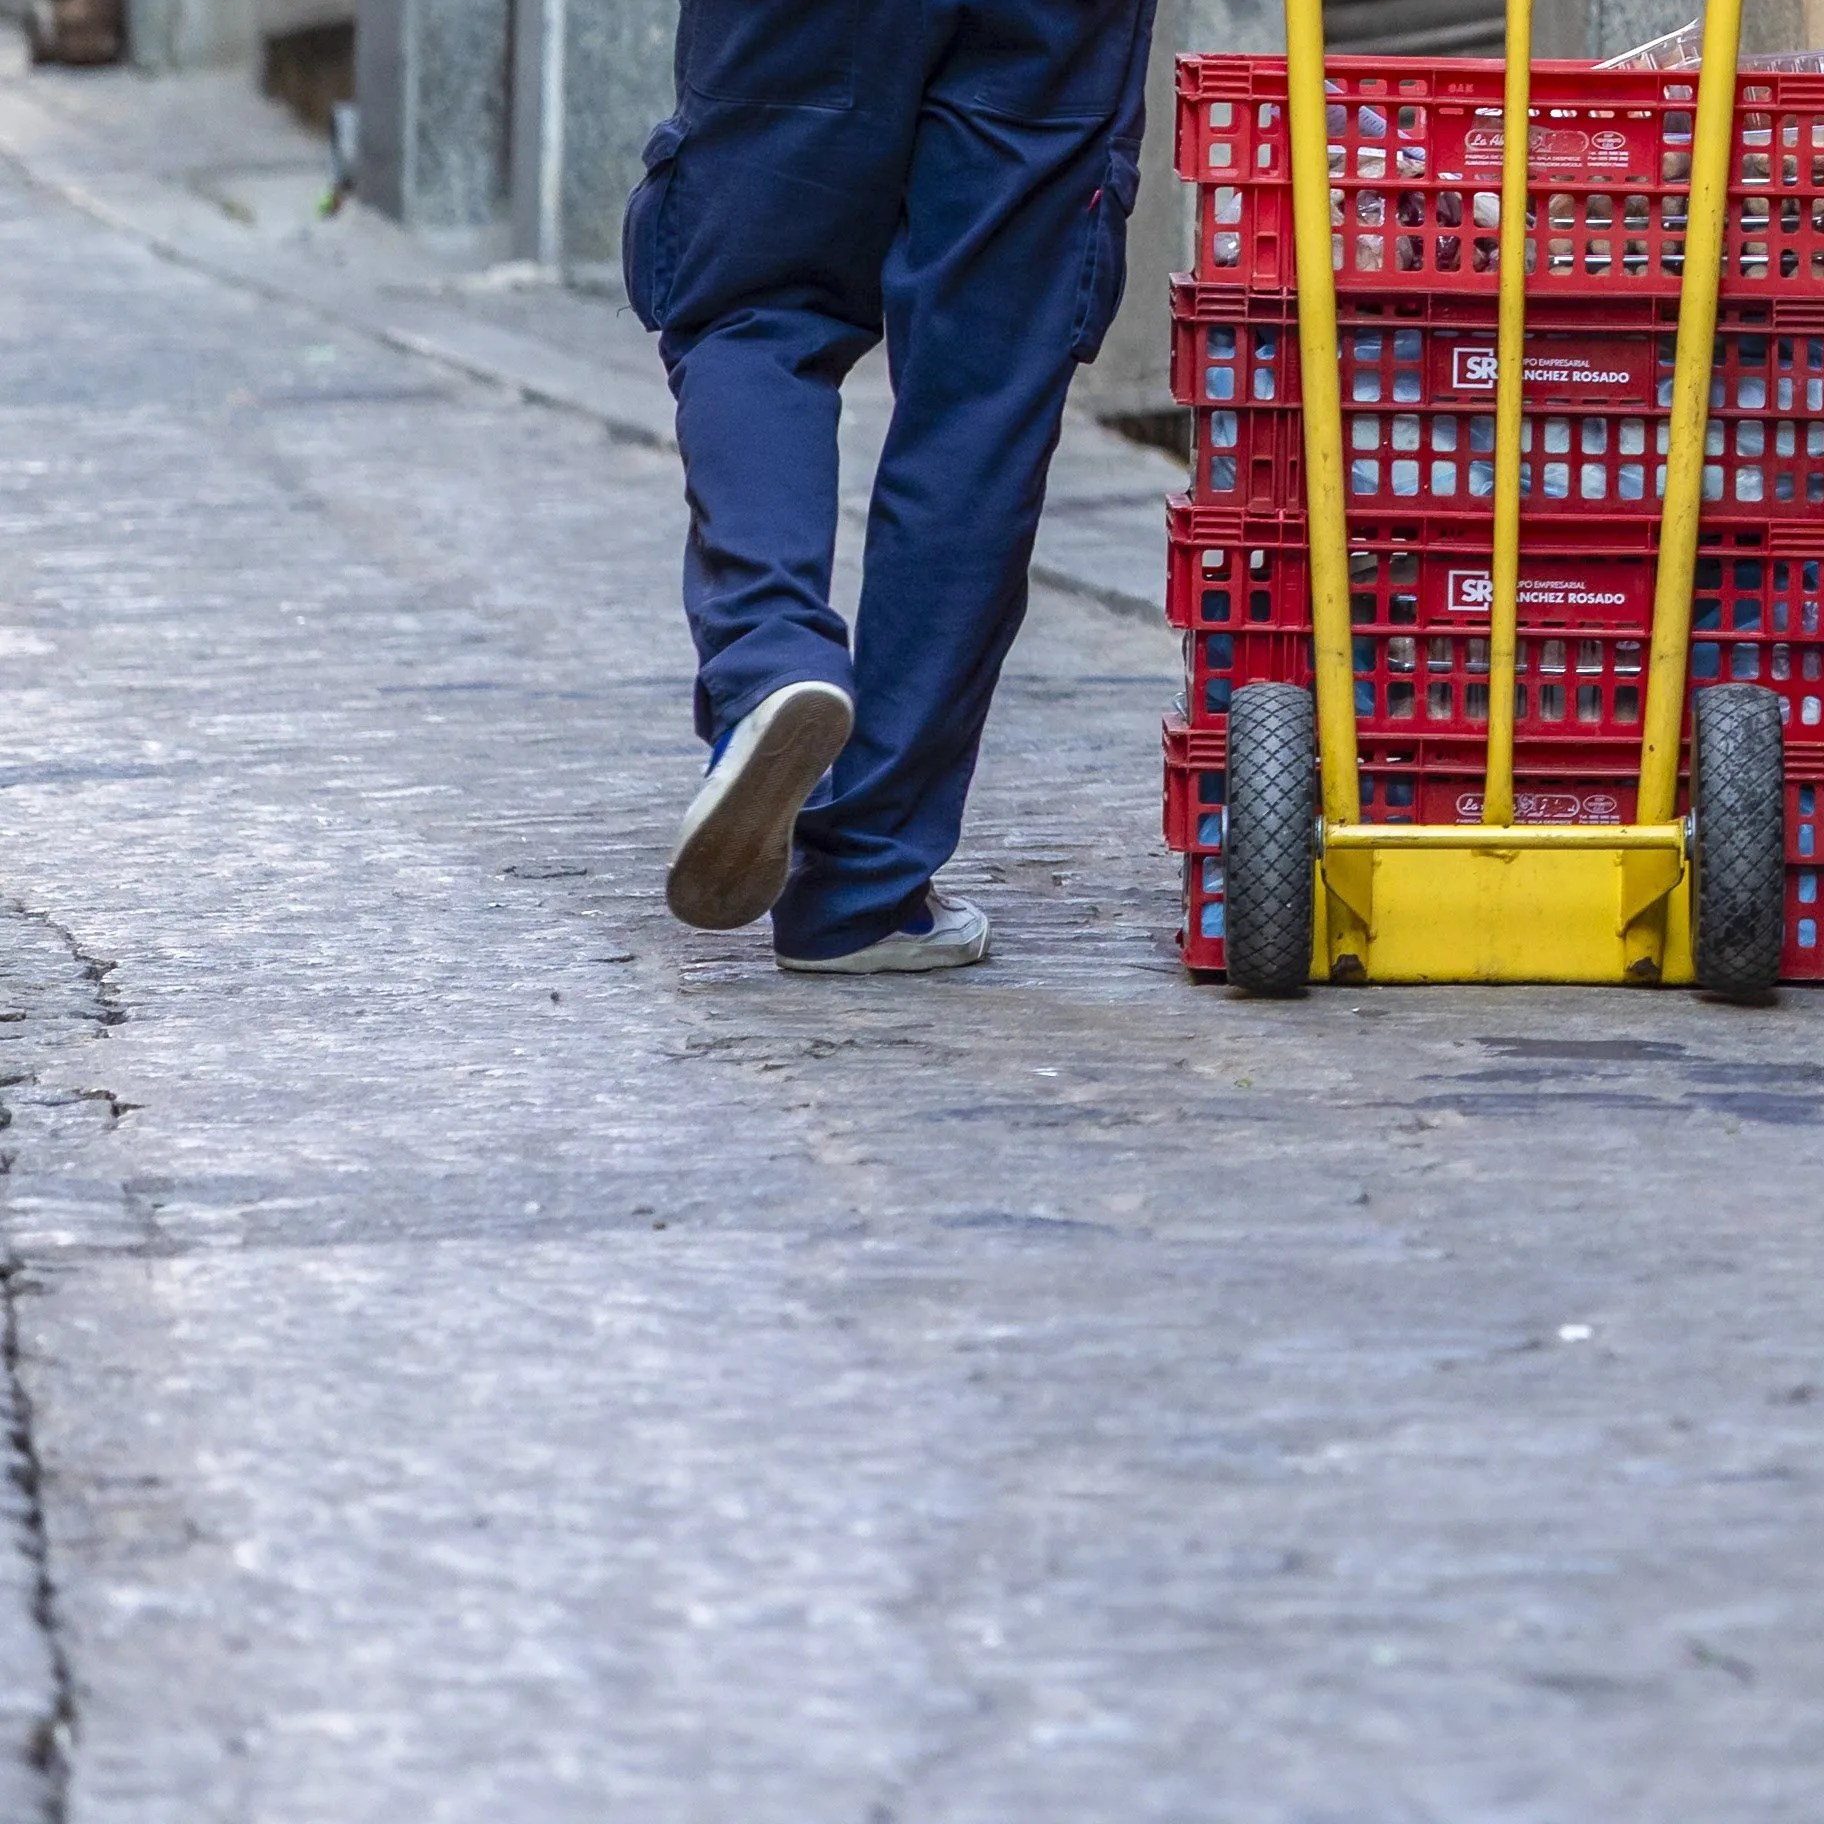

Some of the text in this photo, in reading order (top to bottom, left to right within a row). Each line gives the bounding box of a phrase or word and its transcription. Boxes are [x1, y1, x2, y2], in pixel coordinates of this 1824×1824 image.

[1466, 356, 1499, 380] SR
[1538, 359, 1590, 368] EMPRESARIAL
[1522, 369, 1630, 384] NCHEZ ROSADO
[1461, 579, 1493, 603] SR
[1533, 581, 1586, 590] EMPRESARIAL
[1516, 591, 1626, 605] NCHEZ ROSADO
